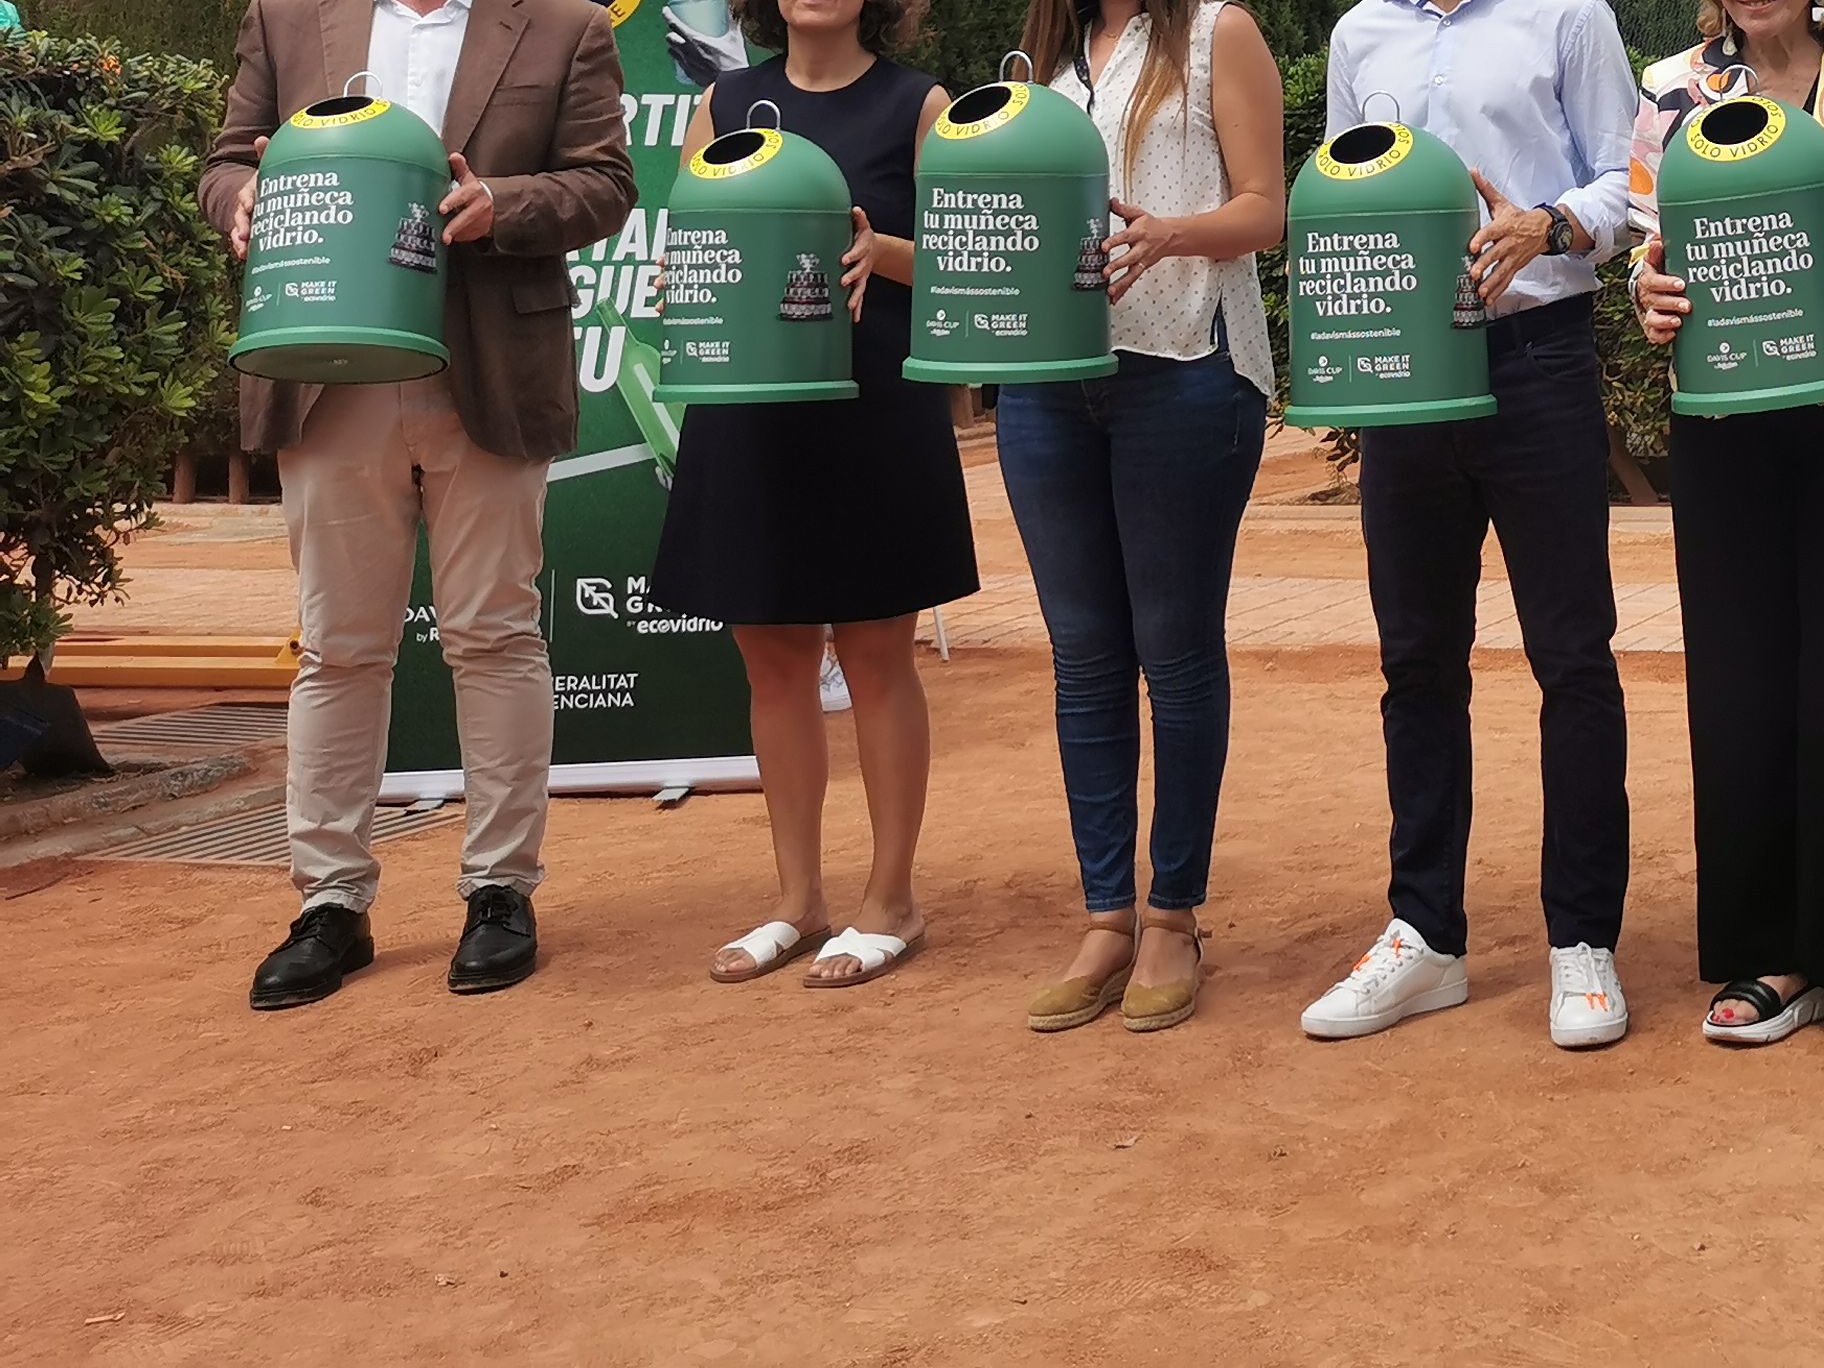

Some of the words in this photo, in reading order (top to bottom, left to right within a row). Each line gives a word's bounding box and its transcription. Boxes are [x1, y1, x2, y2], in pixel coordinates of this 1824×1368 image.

[619, 94, 703, 146] RTI
[1691, 133, 1720, 158] SOLO
[1729, 124, 1779, 158] VIDRIO
[1348, 149, 1401, 176] VIDRIO
[260, 172, 340, 198] Entrena
[266, 188, 354, 211] muñeca
[932, 188, 1024, 209] Entrena
[250, 205, 353, 239] reciclando
[924, 211, 940, 229] tu
[943, 209, 1039, 230] muñeca
[1694, 212, 1794, 239] Entrena
[258, 226, 325, 252] vidrio.
[922, 230, 1040, 251] reciclando
[1307, 232, 1400, 252] Entrena
[1685, 243, 1708, 261] tu
[1713, 231, 1811, 259] muñeca
[670, 245, 742, 265] muñeca
[937, 251, 1012, 272] vidrio.
[1299, 256, 1316, 274] tu
[1320, 250, 1416, 273] muñeca
[1687, 249, 1813, 283] reciclando
[301, 281, 326, 289] MAKE
[327, 280, 337, 288] IT
[1299, 270, 1417, 296] reciclando
[1710, 276, 1792, 303] vidrio.
[1316, 293, 1392, 316] vidrio.
[991, 321, 1027, 329] GREEN
[1780, 335, 1805, 346] MAKE
[1806, 334, 1814, 343] IT
[1780, 343, 1814, 354] GREEN
[1375, 356, 1400, 364] MAKE
[1401, 355, 1410, 363] IT
[1375, 363, 1409, 371] GREEN
[551, 673, 638, 692] ERALITAT
[553, 692, 634, 710] ENCIANA
